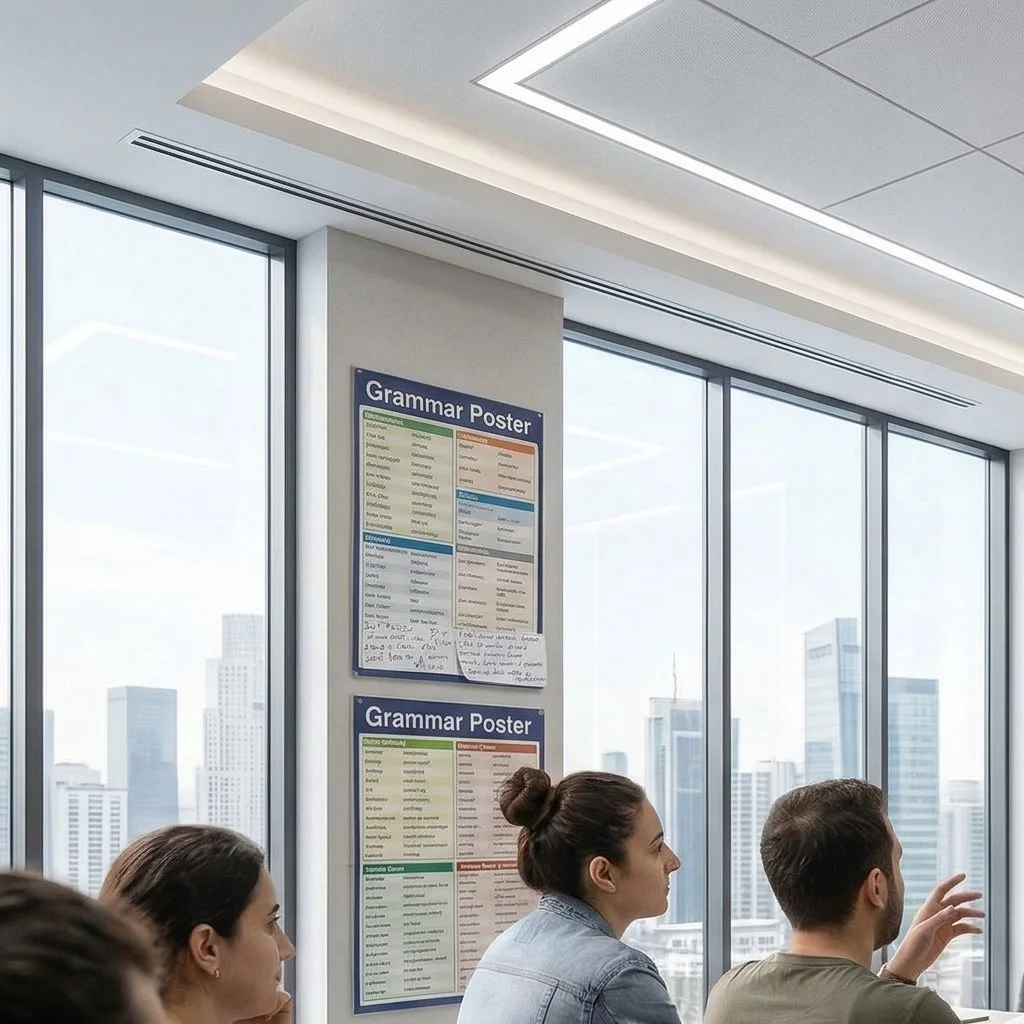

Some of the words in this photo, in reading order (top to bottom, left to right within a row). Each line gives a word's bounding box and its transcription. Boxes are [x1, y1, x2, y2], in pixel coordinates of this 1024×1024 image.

[365, 380, 464, 420] Grammar
[470, 403, 532, 436] Poster
[365, 705, 464, 732] Grammar
[470, 712, 532, 736] Poster
